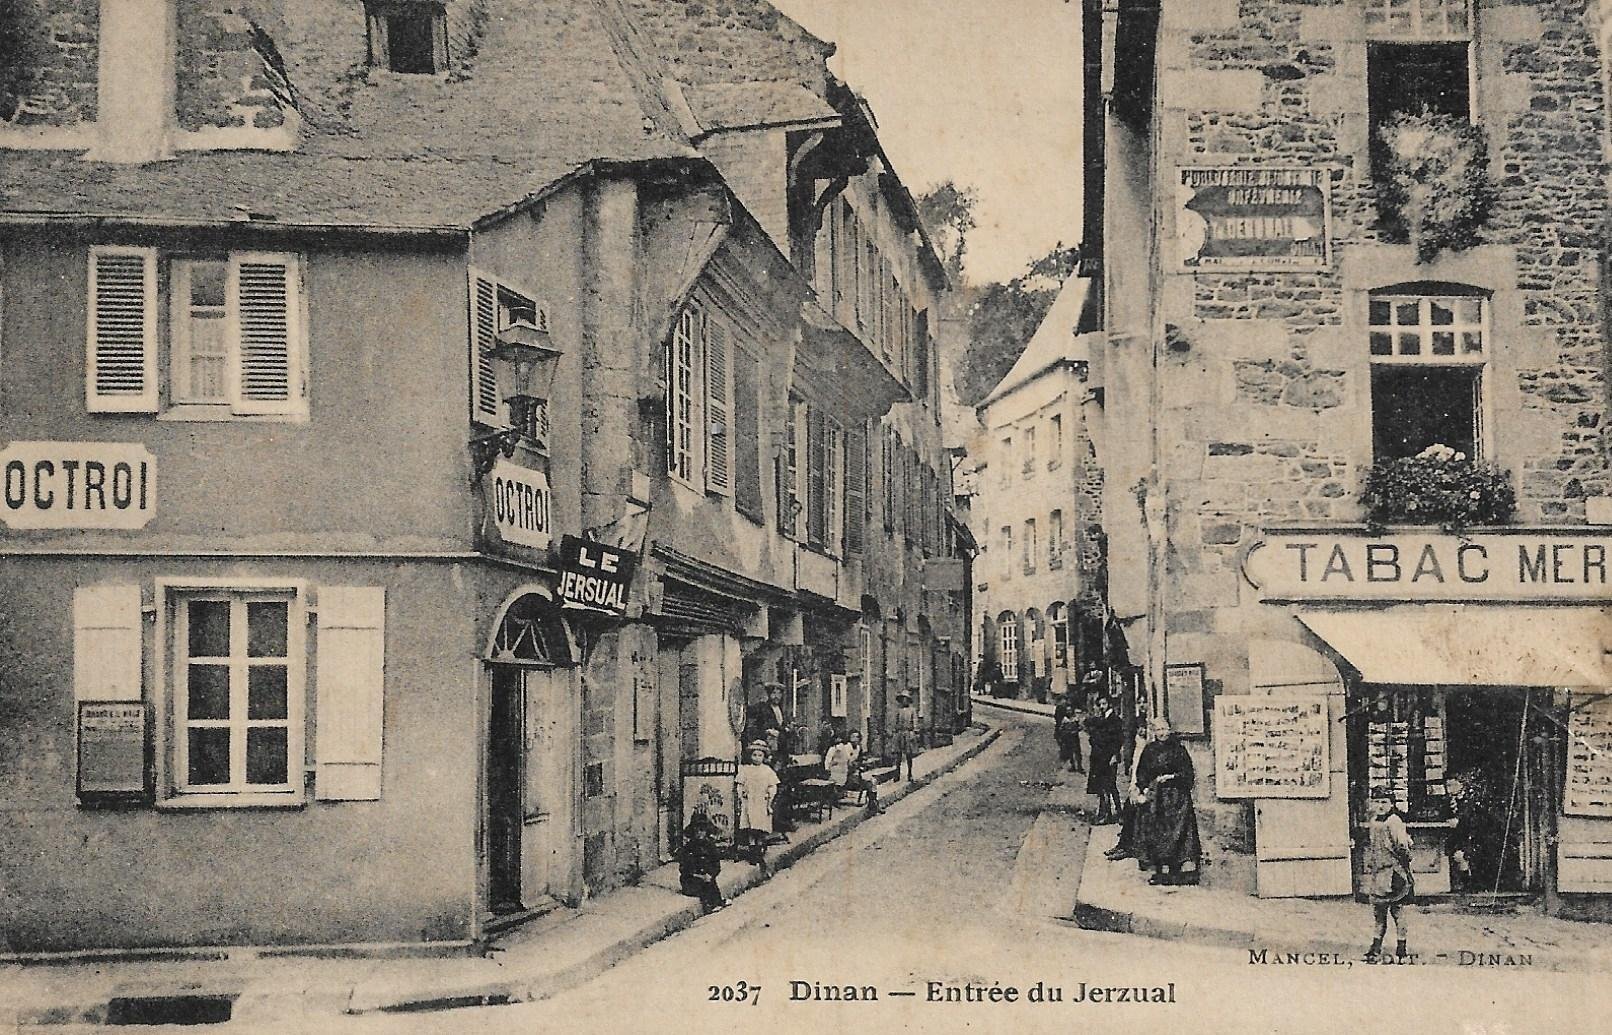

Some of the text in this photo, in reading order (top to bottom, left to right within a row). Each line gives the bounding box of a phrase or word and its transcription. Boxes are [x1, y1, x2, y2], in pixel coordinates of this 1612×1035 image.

[5, 460, 147, 509] OCTROI
[495, 477, 549, 533] OCTROI
[579, 546, 619, 573] LE
[1286, 543, 1606, 583] TABAC MER
[557, 570, 627, 610] JERSUAL
